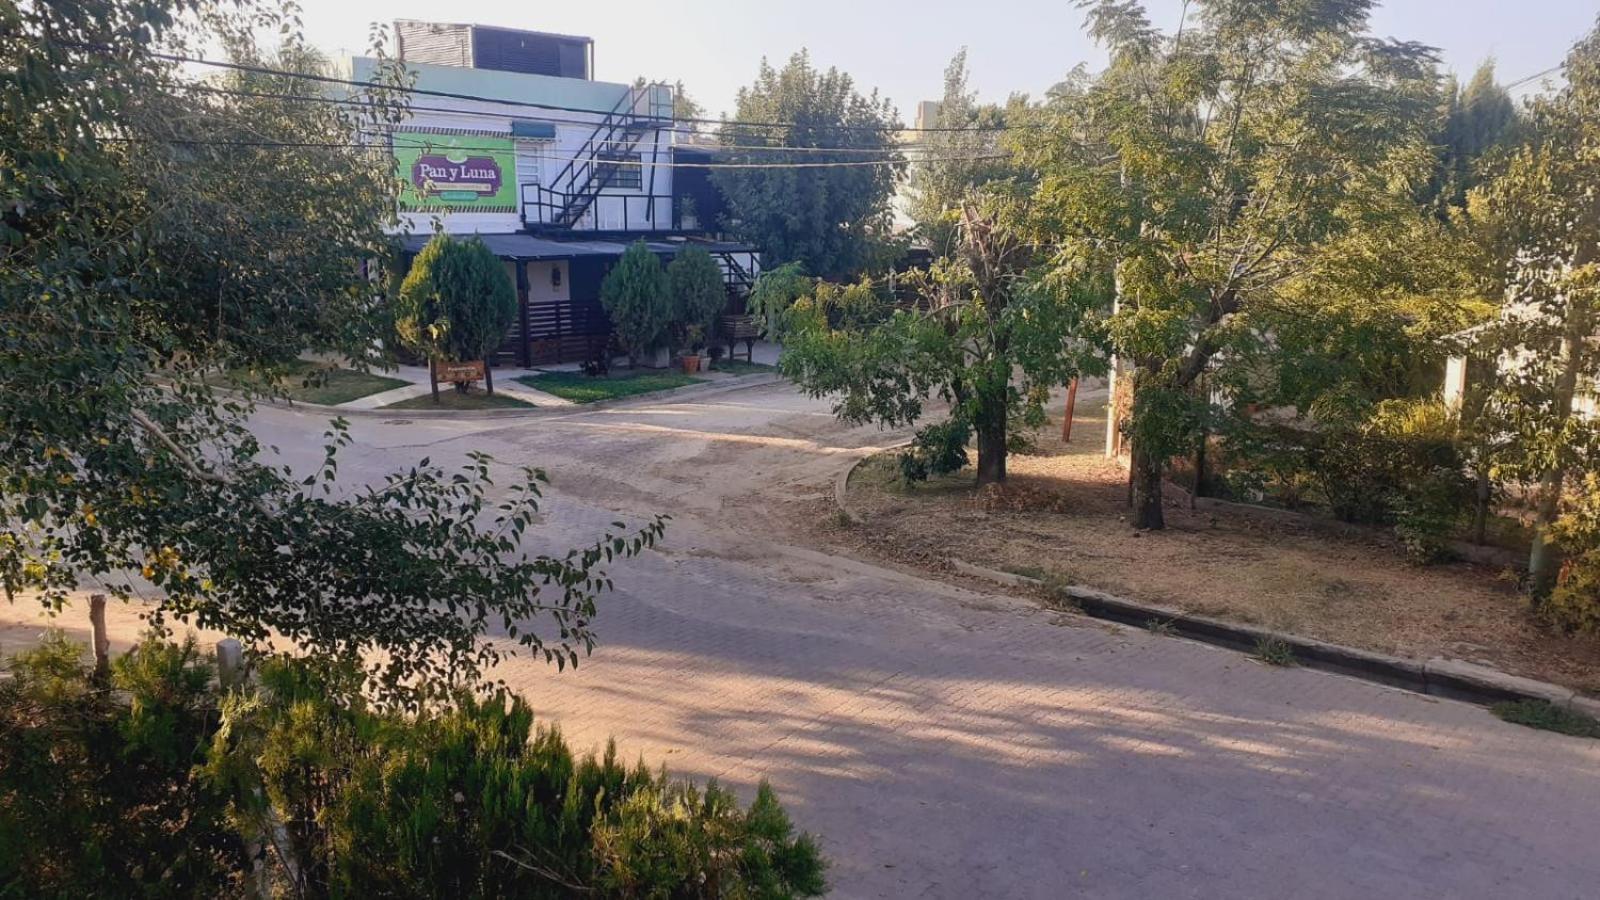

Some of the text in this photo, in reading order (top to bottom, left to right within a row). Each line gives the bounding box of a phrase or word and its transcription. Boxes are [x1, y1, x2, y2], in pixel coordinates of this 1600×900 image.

[420, 164, 497, 181] Pan y Luna
